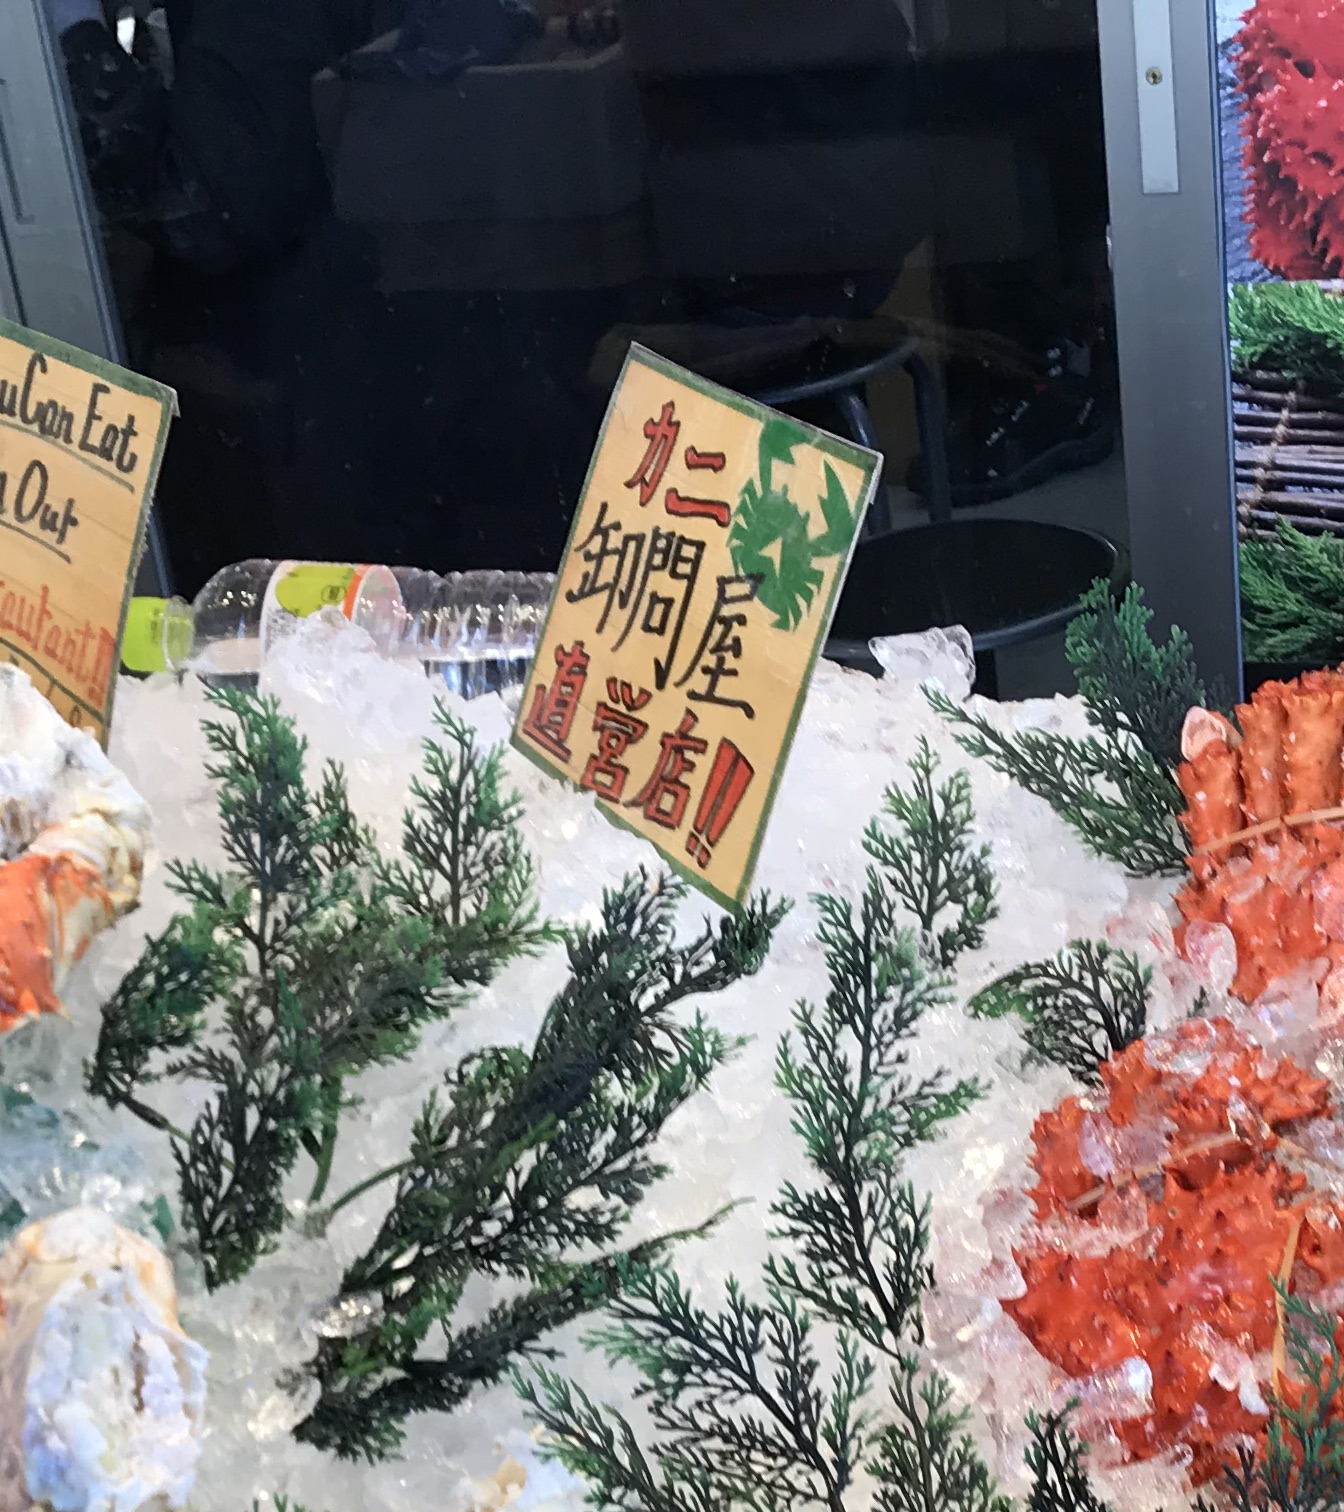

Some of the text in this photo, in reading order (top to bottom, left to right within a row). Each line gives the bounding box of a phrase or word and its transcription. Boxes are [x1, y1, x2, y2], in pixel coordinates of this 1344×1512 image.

[78, 383, 138, 474] Eat
[623, 399, 732, 528] カニ
[13, 459, 79, 545] Out
